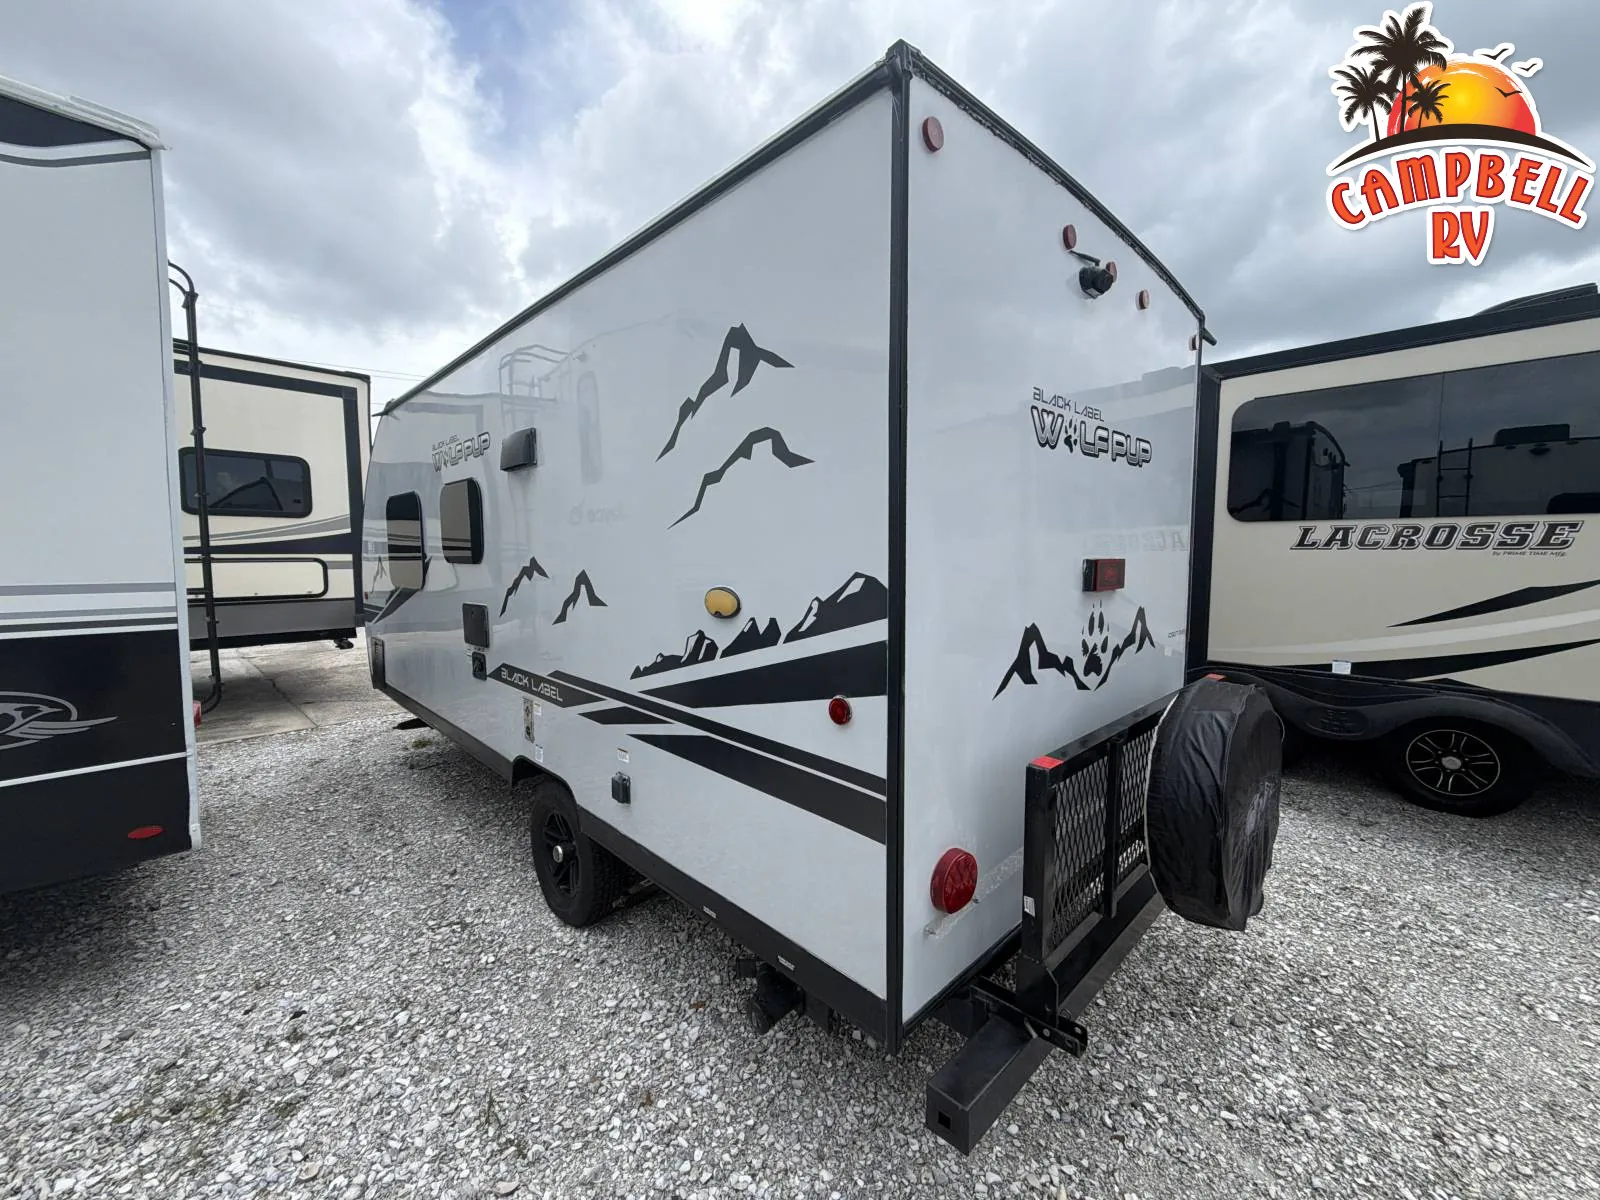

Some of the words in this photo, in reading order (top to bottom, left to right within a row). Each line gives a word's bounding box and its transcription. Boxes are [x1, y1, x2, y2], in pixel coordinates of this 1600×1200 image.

[1032, 386, 1072, 412] BLACK
[1074, 401, 1105, 422] LABEL
[1111, 430, 1153, 468] PUP
[1290, 520, 1584, 551] LACROSSE
[501, 667, 530, 688] BLACK
[531, 679, 564, 702] LABEL
